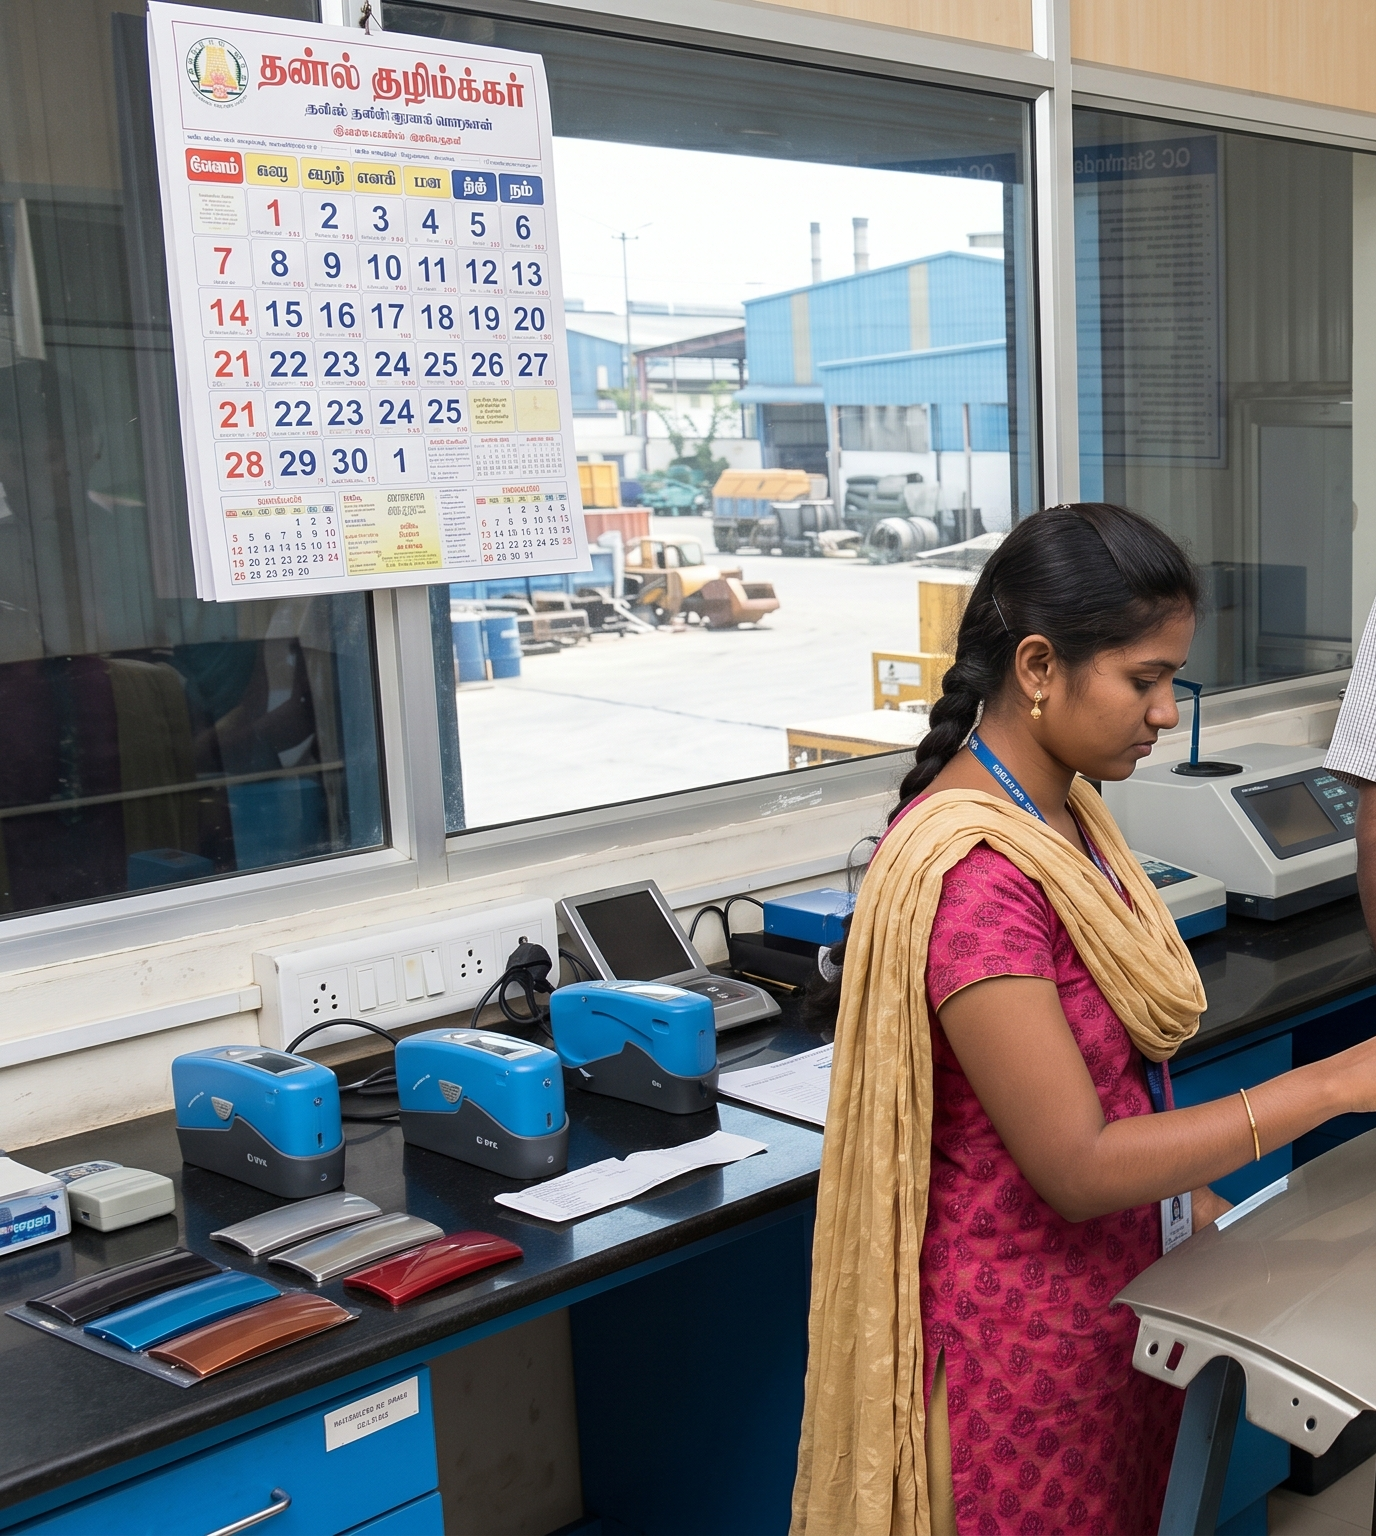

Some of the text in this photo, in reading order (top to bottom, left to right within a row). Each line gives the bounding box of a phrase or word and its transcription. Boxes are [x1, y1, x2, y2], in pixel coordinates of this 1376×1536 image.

[267, 199, 530, 240] 1 2 3 4 5 6
[214, 247, 542, 286] 7 8 9 10 11 12 13
[211, 299, 544, 331] 14 15 16 17 18 19 20
[215, 350, 547, 377] 21 22 23 24 25 26 27
[220, 399, 461, 428] 21 22 23 24 25
[225, 448, 405, 478] 28 29 30 1
[248, 546, 258, 554] 12
[297, 555, 308, 563] 22
[328, 553, 338, 561] 24
[482, 542, 492, 550] 20
